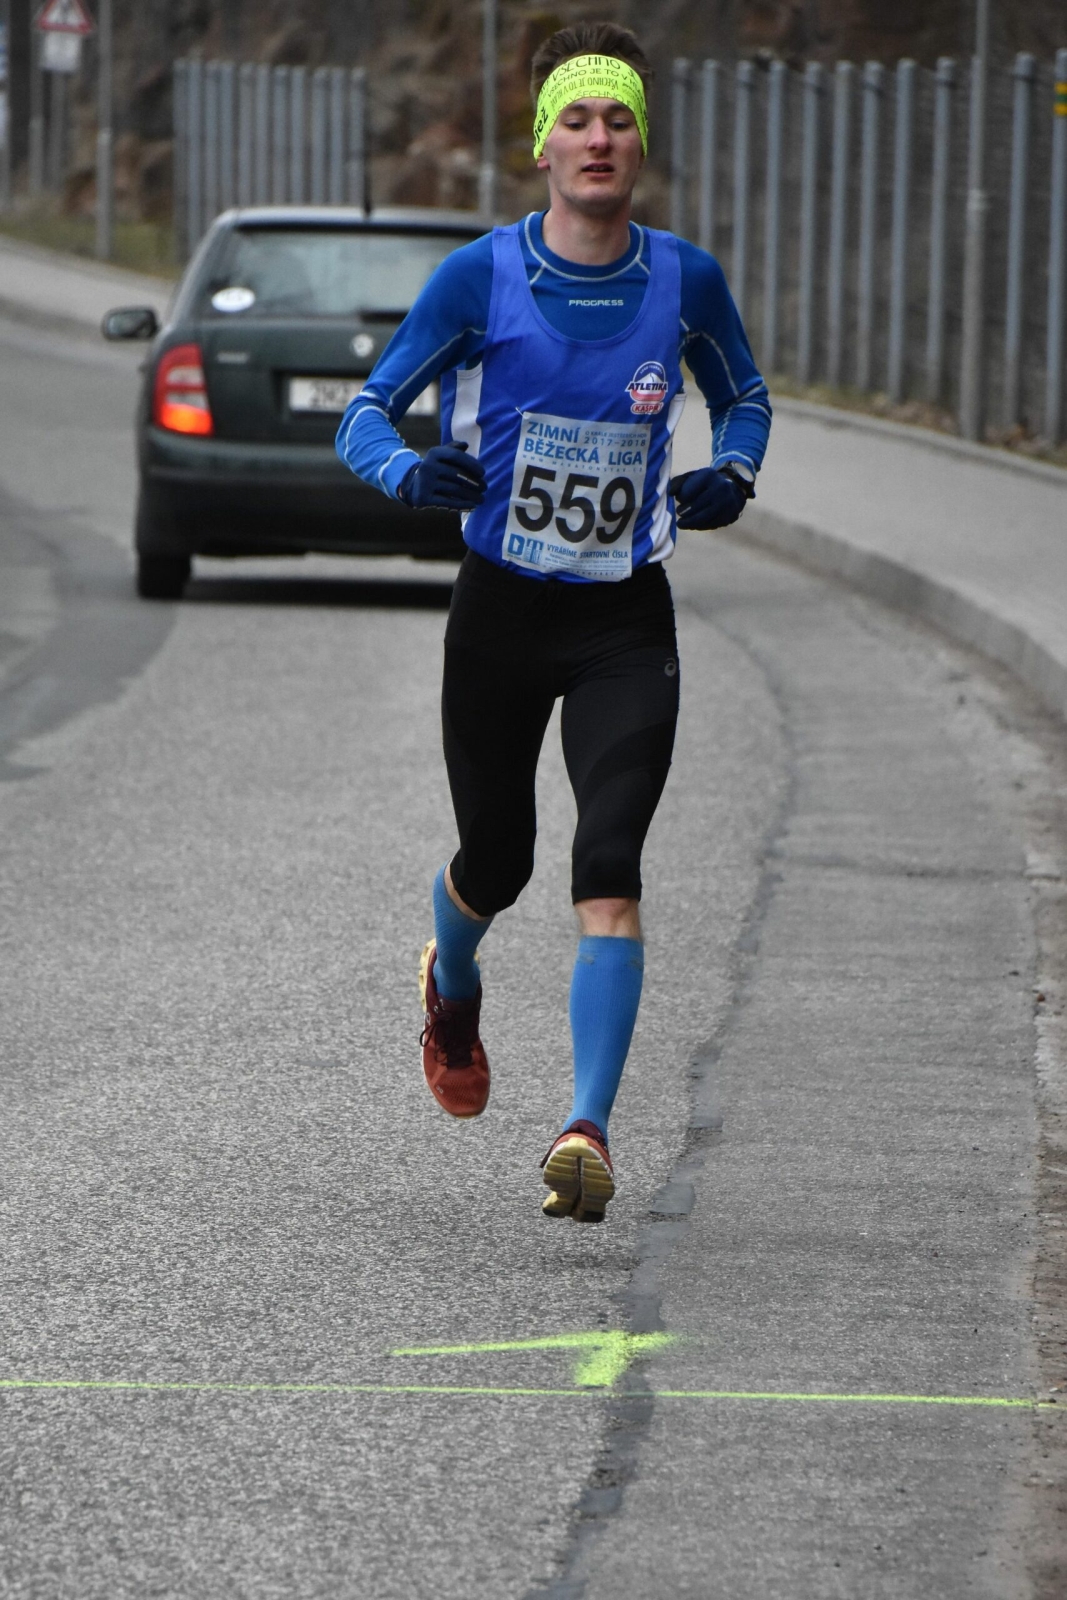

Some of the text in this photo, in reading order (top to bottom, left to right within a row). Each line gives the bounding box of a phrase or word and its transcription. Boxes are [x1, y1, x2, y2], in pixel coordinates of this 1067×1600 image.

[604, 68, 619, 77] TO
[568, 299, 624, 307] PROGRESS
[628, 382, 667, 391] ATLETIKA
[527, 421, 581, 443] ZIMNÍ
[523, 438, 643, 466] BĚŽECKÁ LIGA
[514, 464, 636, 544] 559
[547, 544, 578, 558] VYRÁBÍME
[579, 549, 610, 559] STARTOVNÍ
[611, 549, 629, 558] ČÍSLA
